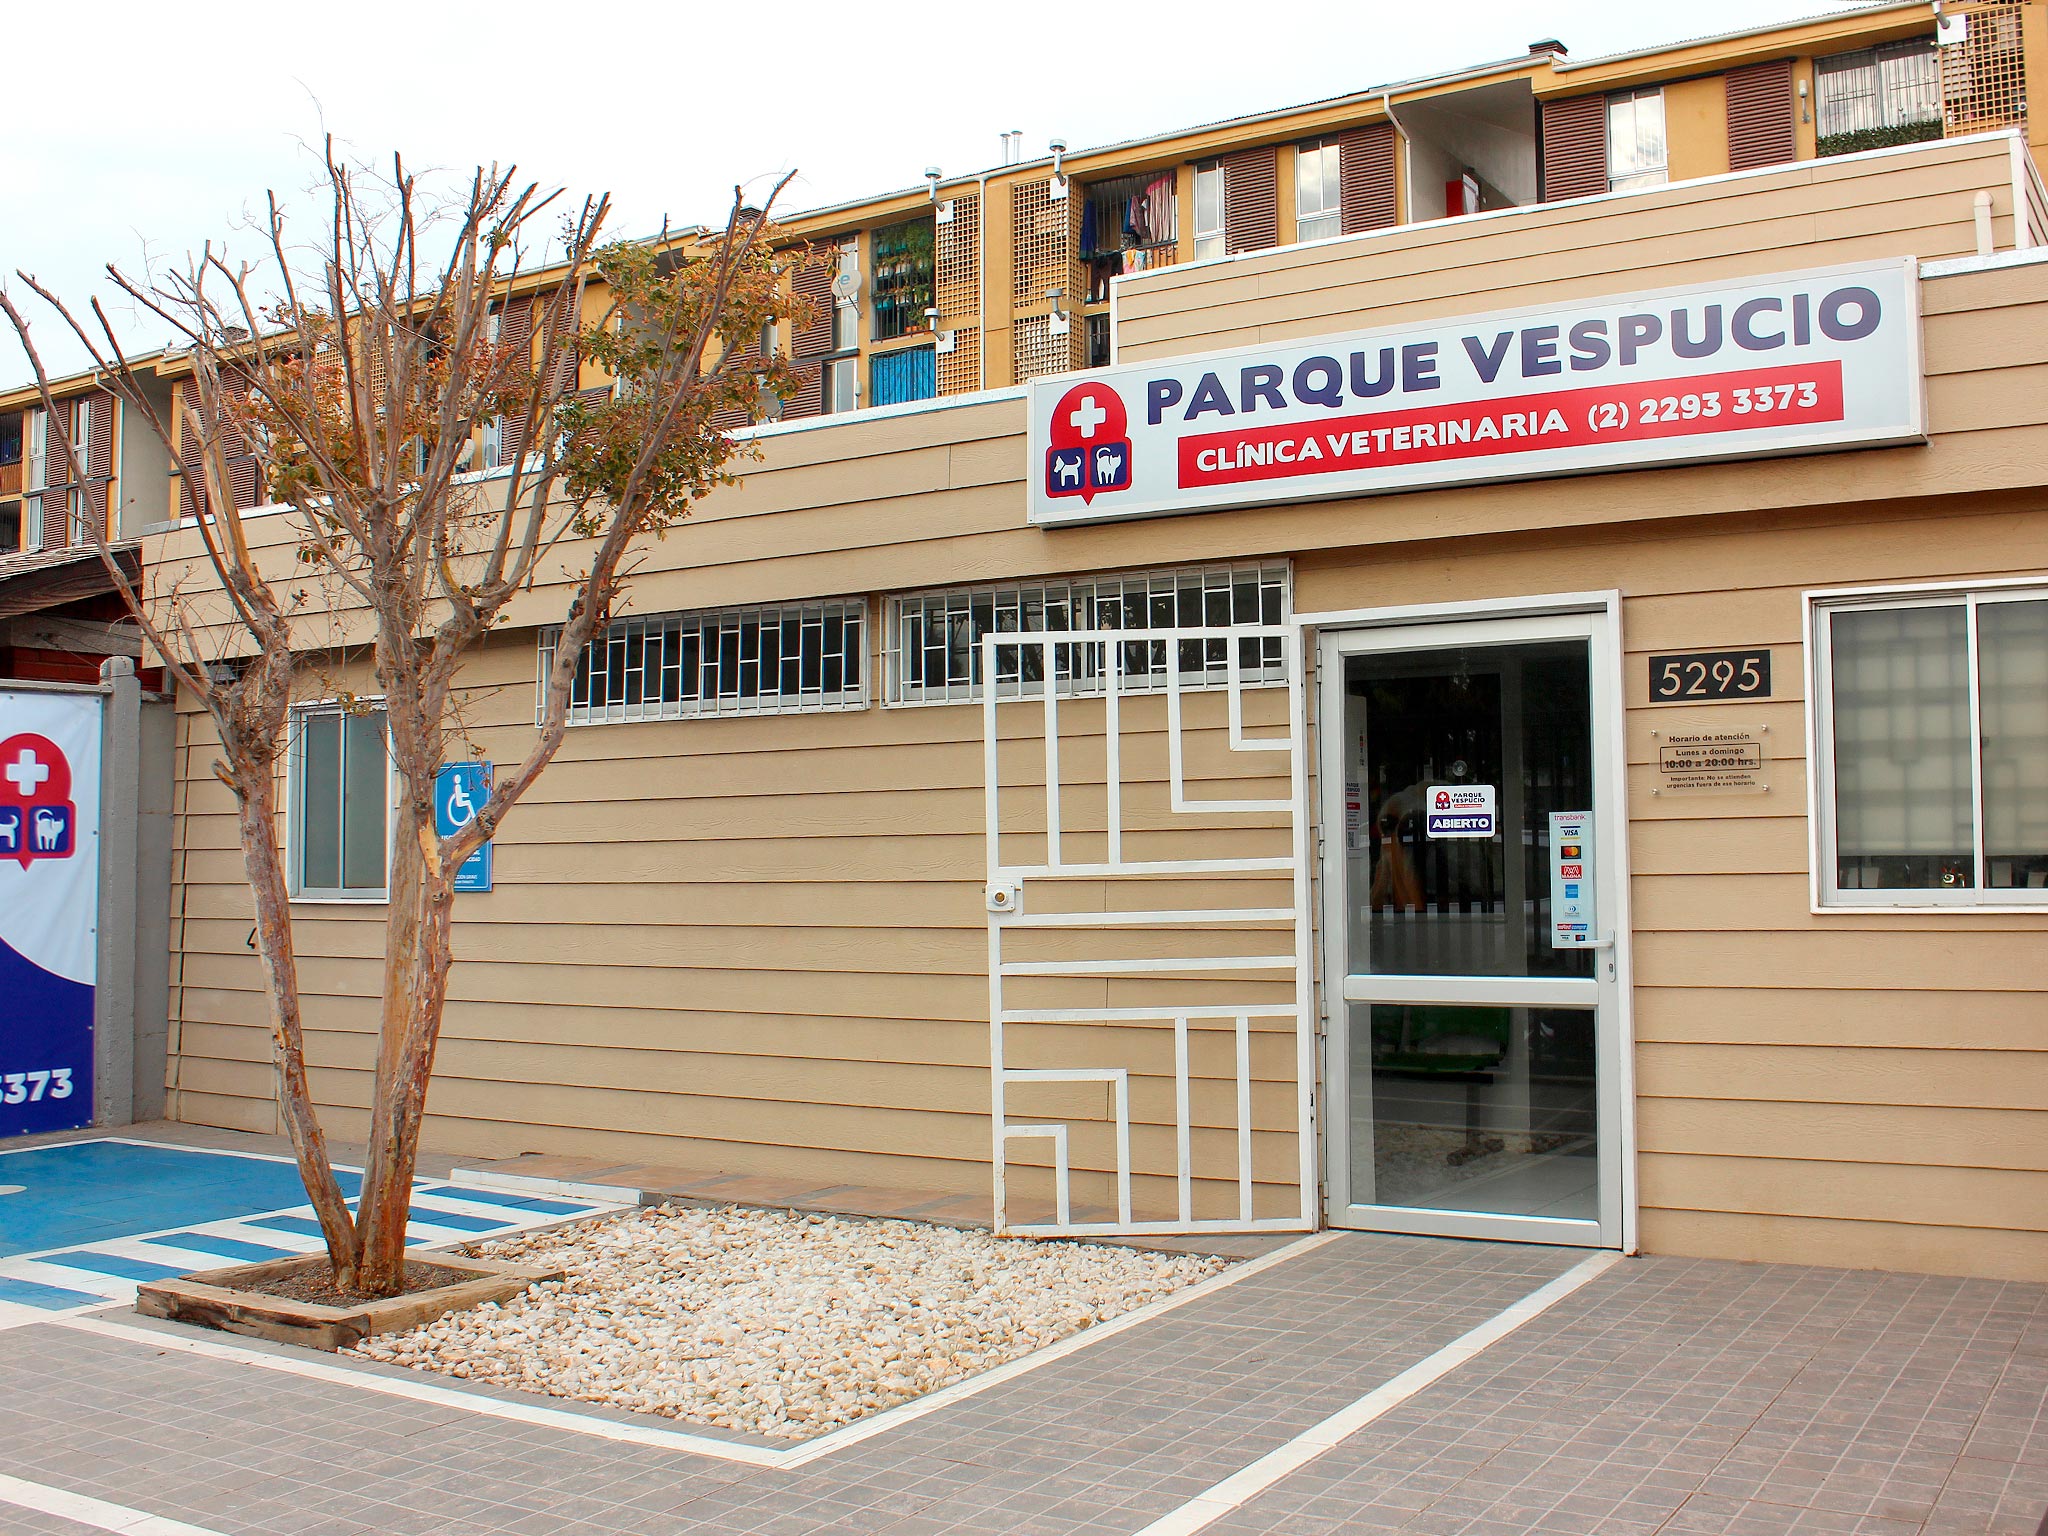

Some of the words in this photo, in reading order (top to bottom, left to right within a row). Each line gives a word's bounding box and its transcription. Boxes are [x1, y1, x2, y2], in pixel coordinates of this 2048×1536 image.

[1148, 342, 1441, 425] PARQUE
[1461, 287, 1881, 383] VESPUCIO
[1196, 437, 1323, 472] CLÍNICA
[1326, 408, 1568, 457] VETERINARIA
[1587, 401, 1629, 432] (2)
[1639, 391, 1722, 424] 2293
[1732, 381, 1818, 415] 3373
[1658, 658, 1760, 696] 5295
[1669, 735, 1700, 743] Horario
[1702, 734, 1712, 742] de
[1714, 733, 1750, 741] atención
[1664, 760, 1692, 768] 10:00
[1704, 758, 1735, 767] 20:00
[1737, 757, 1757, 766] hrs.
[1432, 818, 1489, 829] ABIERTO
[0, 1068, 74, 1104] 373
